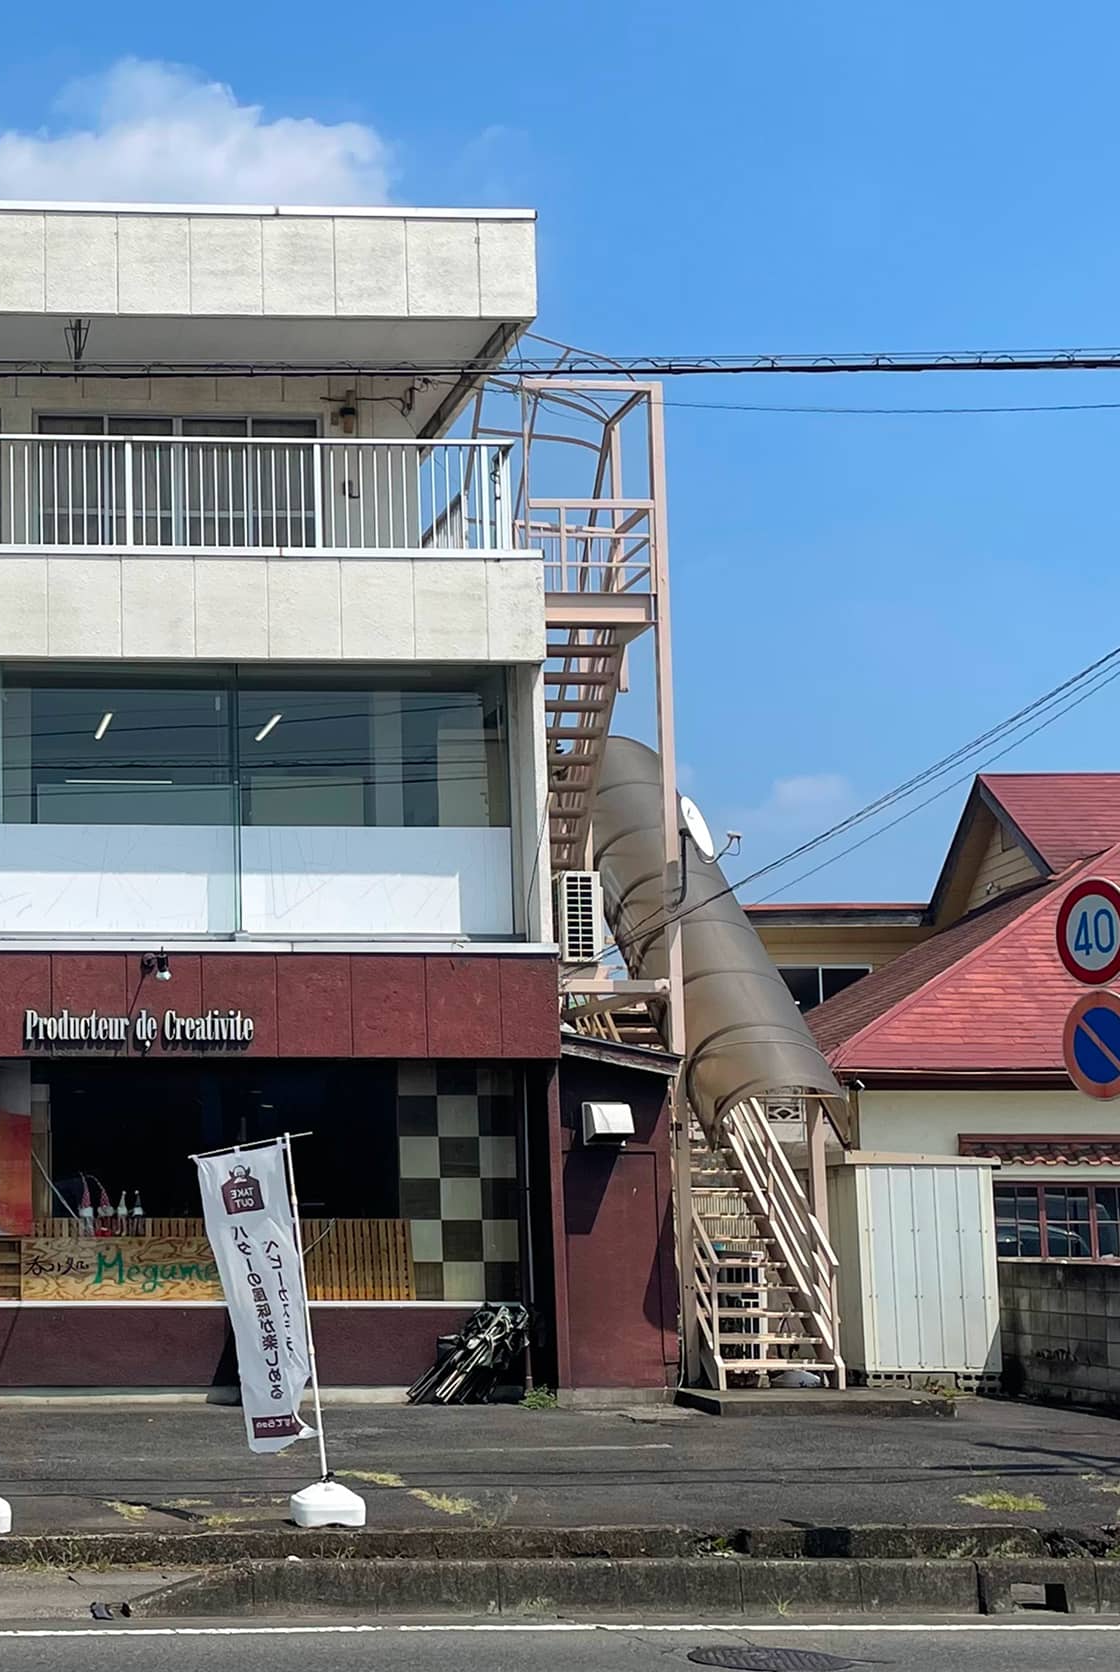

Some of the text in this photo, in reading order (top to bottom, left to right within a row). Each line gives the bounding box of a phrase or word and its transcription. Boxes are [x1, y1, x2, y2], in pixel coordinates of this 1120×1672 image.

[1074, 908, 1115, 956] 40
[25, 1010, 254, 1040] Producteur de Creativite
